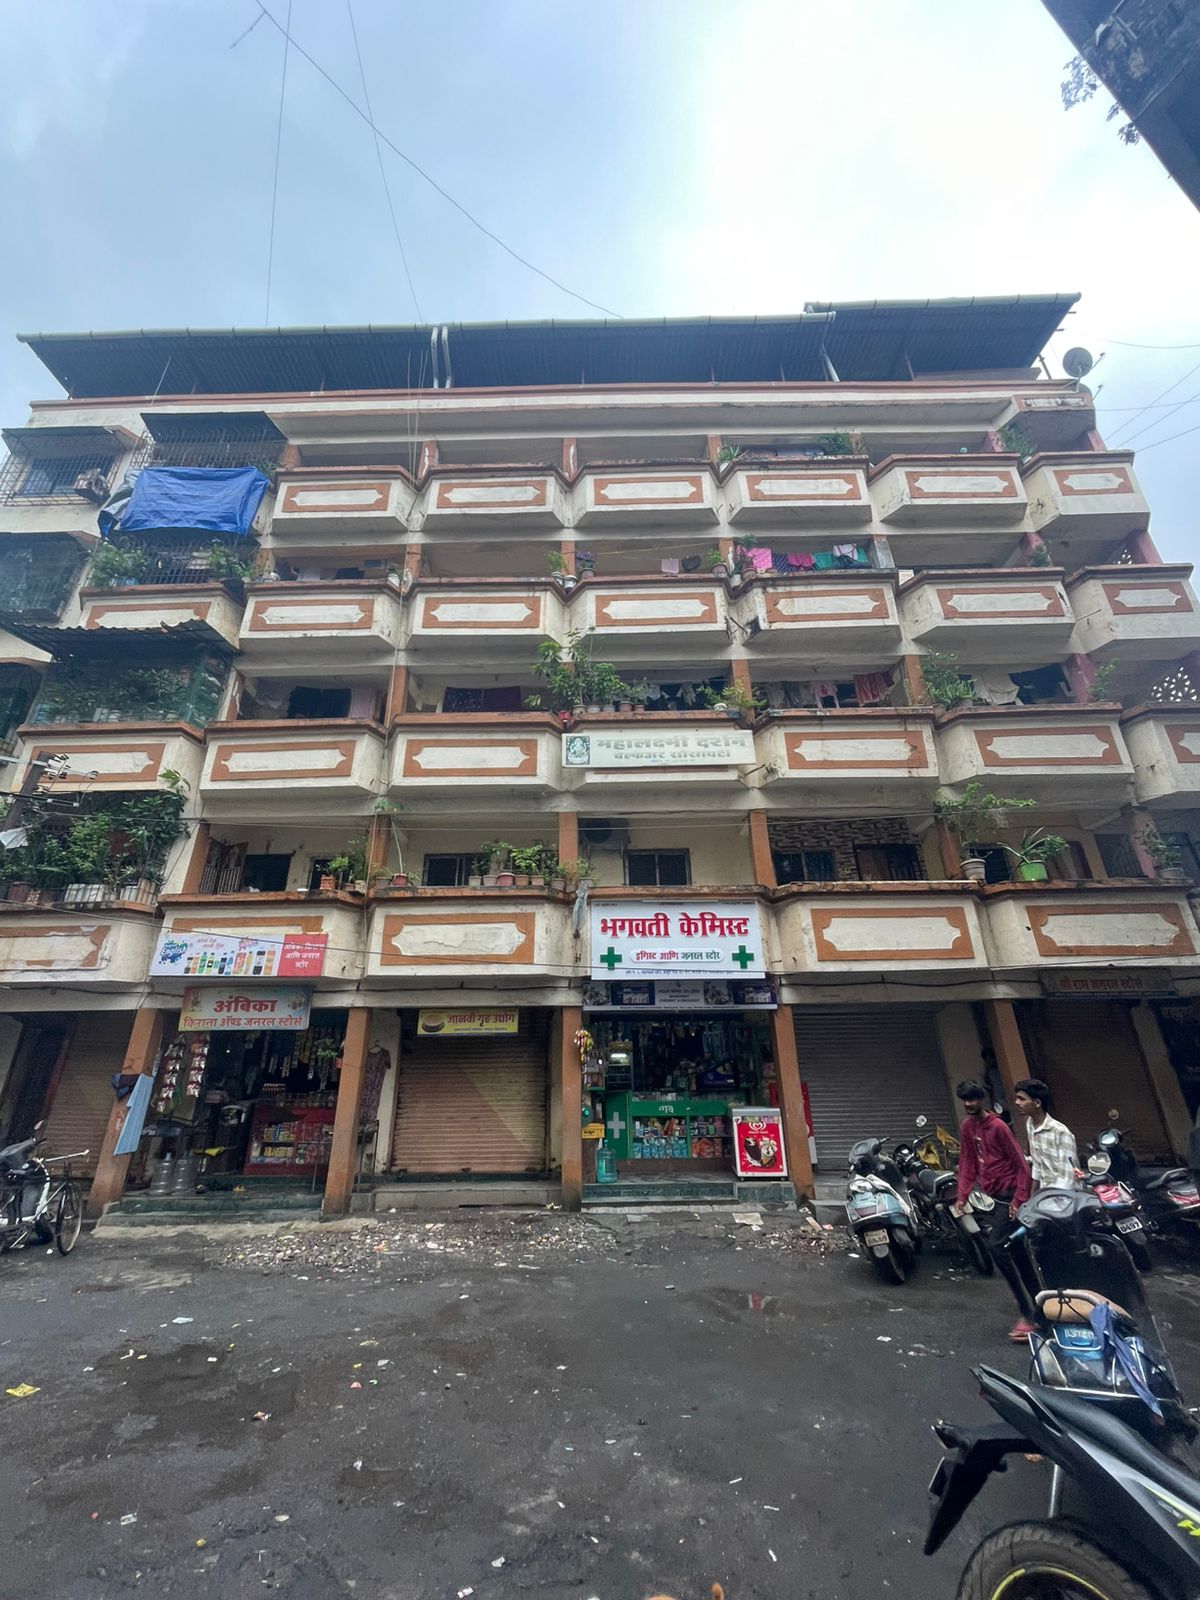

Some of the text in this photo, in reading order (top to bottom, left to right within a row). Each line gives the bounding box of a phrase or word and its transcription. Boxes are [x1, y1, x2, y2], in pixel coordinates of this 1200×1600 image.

[600, 911, 750, 937] भगवती केमिस्ट
[659, 951, 679, 961] आणि
[681, 951, 704, 961] जनरल
[705, 950, 721, 960] स्टोर
[213, 995, 278, 1013] अंबिका
[244, 1017, 276, 1027] जनरल
